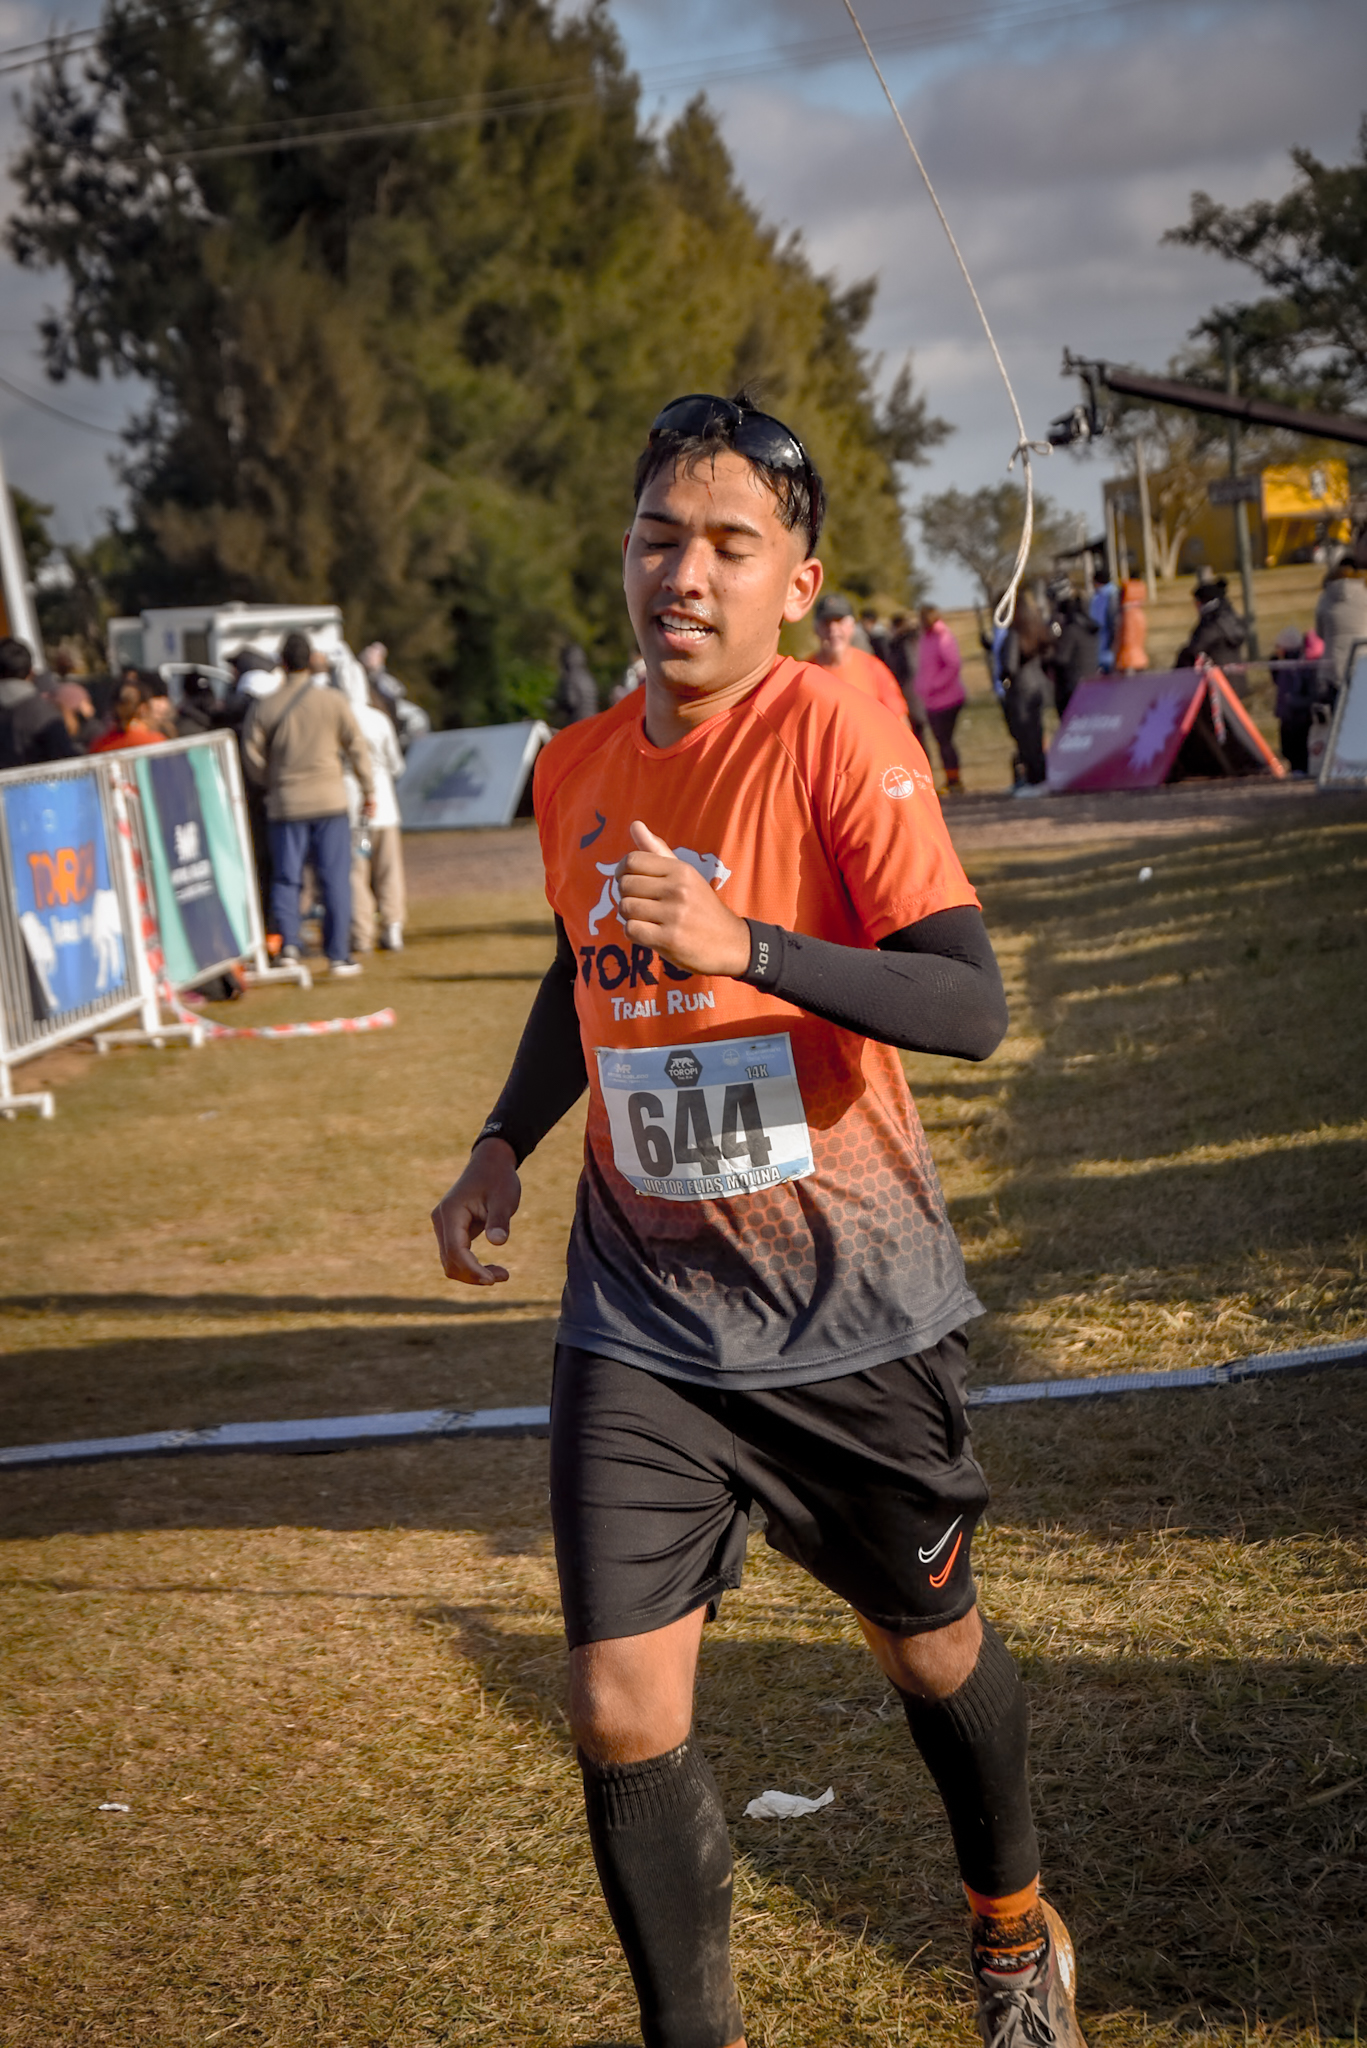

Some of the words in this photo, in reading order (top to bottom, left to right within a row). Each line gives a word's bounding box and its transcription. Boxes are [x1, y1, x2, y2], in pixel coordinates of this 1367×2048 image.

[668, 1067, 698, 1077] TOROPI
[745, 1064, 769, 1079] 14K
[628, 1083, 772, 1177] 644
[643, 1178, 685, 1195] VICTOR
[686, 1176, 724, 1195] ELIAS
[725, 1165, 781, 1190] MOLINA
